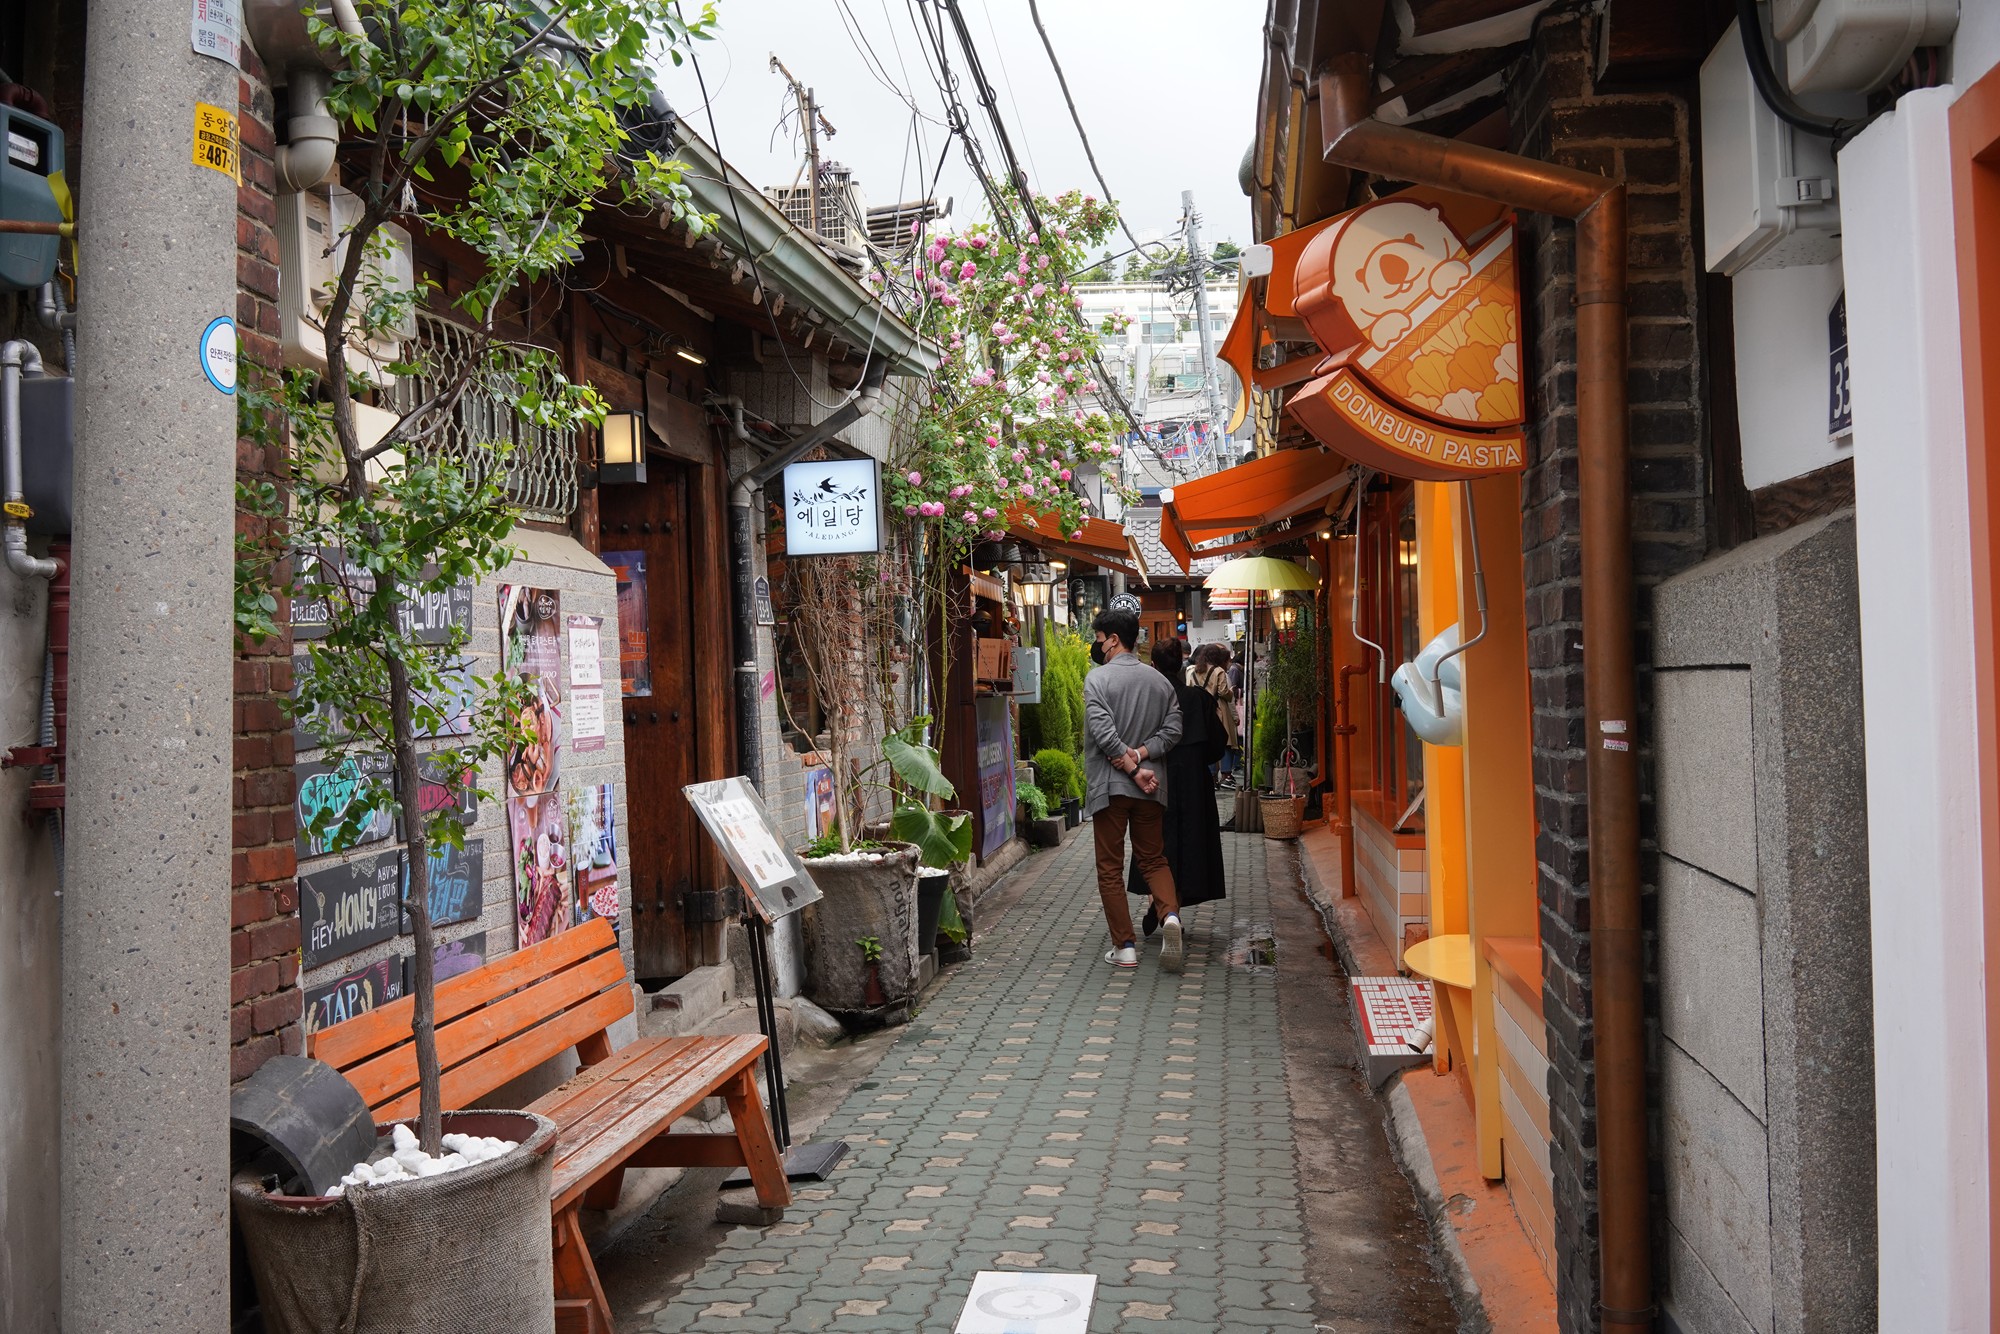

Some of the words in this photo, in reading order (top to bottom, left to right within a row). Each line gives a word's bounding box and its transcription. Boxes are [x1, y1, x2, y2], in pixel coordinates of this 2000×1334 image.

[1333, 381, 1435, 454] DONBURI
[1441, 439, 1521, 466] PASTA
[797, 504, 863, 527] 에일당
[808, 529, 854, 541] ALEDANG
[378, 865, 391, 883] ABV
[311, 921, 334, 951] HEY
[335, 886, 378, 939] HONEY
[321, 983, 358, 1027] TAP
